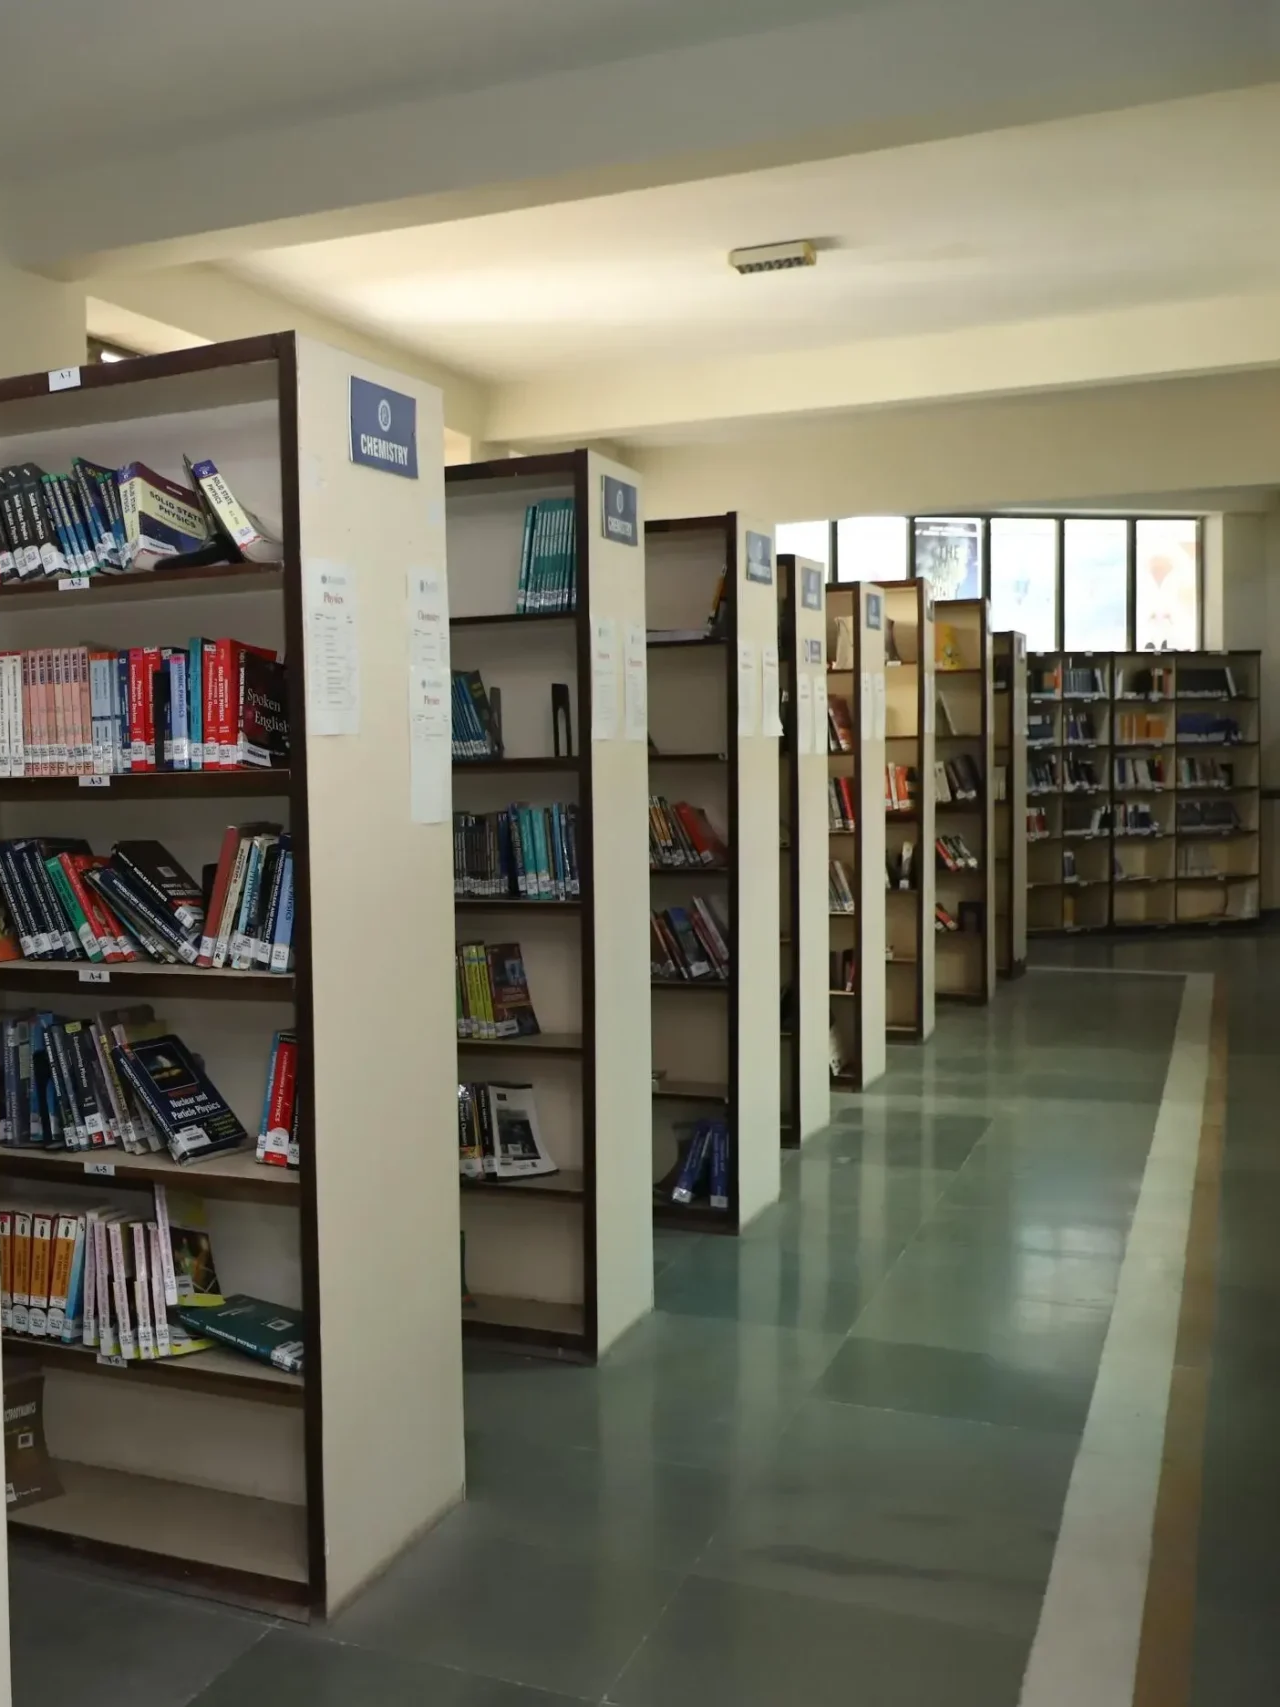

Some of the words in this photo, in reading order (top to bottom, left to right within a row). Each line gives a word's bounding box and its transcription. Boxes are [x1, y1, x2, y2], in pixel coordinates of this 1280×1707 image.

[360, 433, 409, 466] CHEMISTRY
[206, 484, 222, 504] PHYSICS
[212, 476, 223, 490] SOLID
[222, 491, 234, 505] STATE
[150, 491, 176, 510] SOLID
[177, 506, 202, 523] STATE
[158, 505, 196, 529] PHYSICS
[20, 522, 28, 540] Physics
[36, 521, 44, 540] Physics
[248, 688, 280, 712] Spoken
[134, 867, 151, 884] NUCLEAR
[150, 884, 168, 902] PHYSICS
[113, 879, 138, 904] INTRODUCTORY
[138, 902, 156, 918] NUCLEAR
[160, 924, 178, 941] PARTICLE
[170, 1096, 195, 1108] Nuclear
[196, 1093, 208, 1104] and
[172, 1108, 196, 1120] Particle
[196, 1102, 220, 1116] Physics
[94, 1165, 107, 1173] A-5
[236, 1336, 258, 1350] PHYSICS
